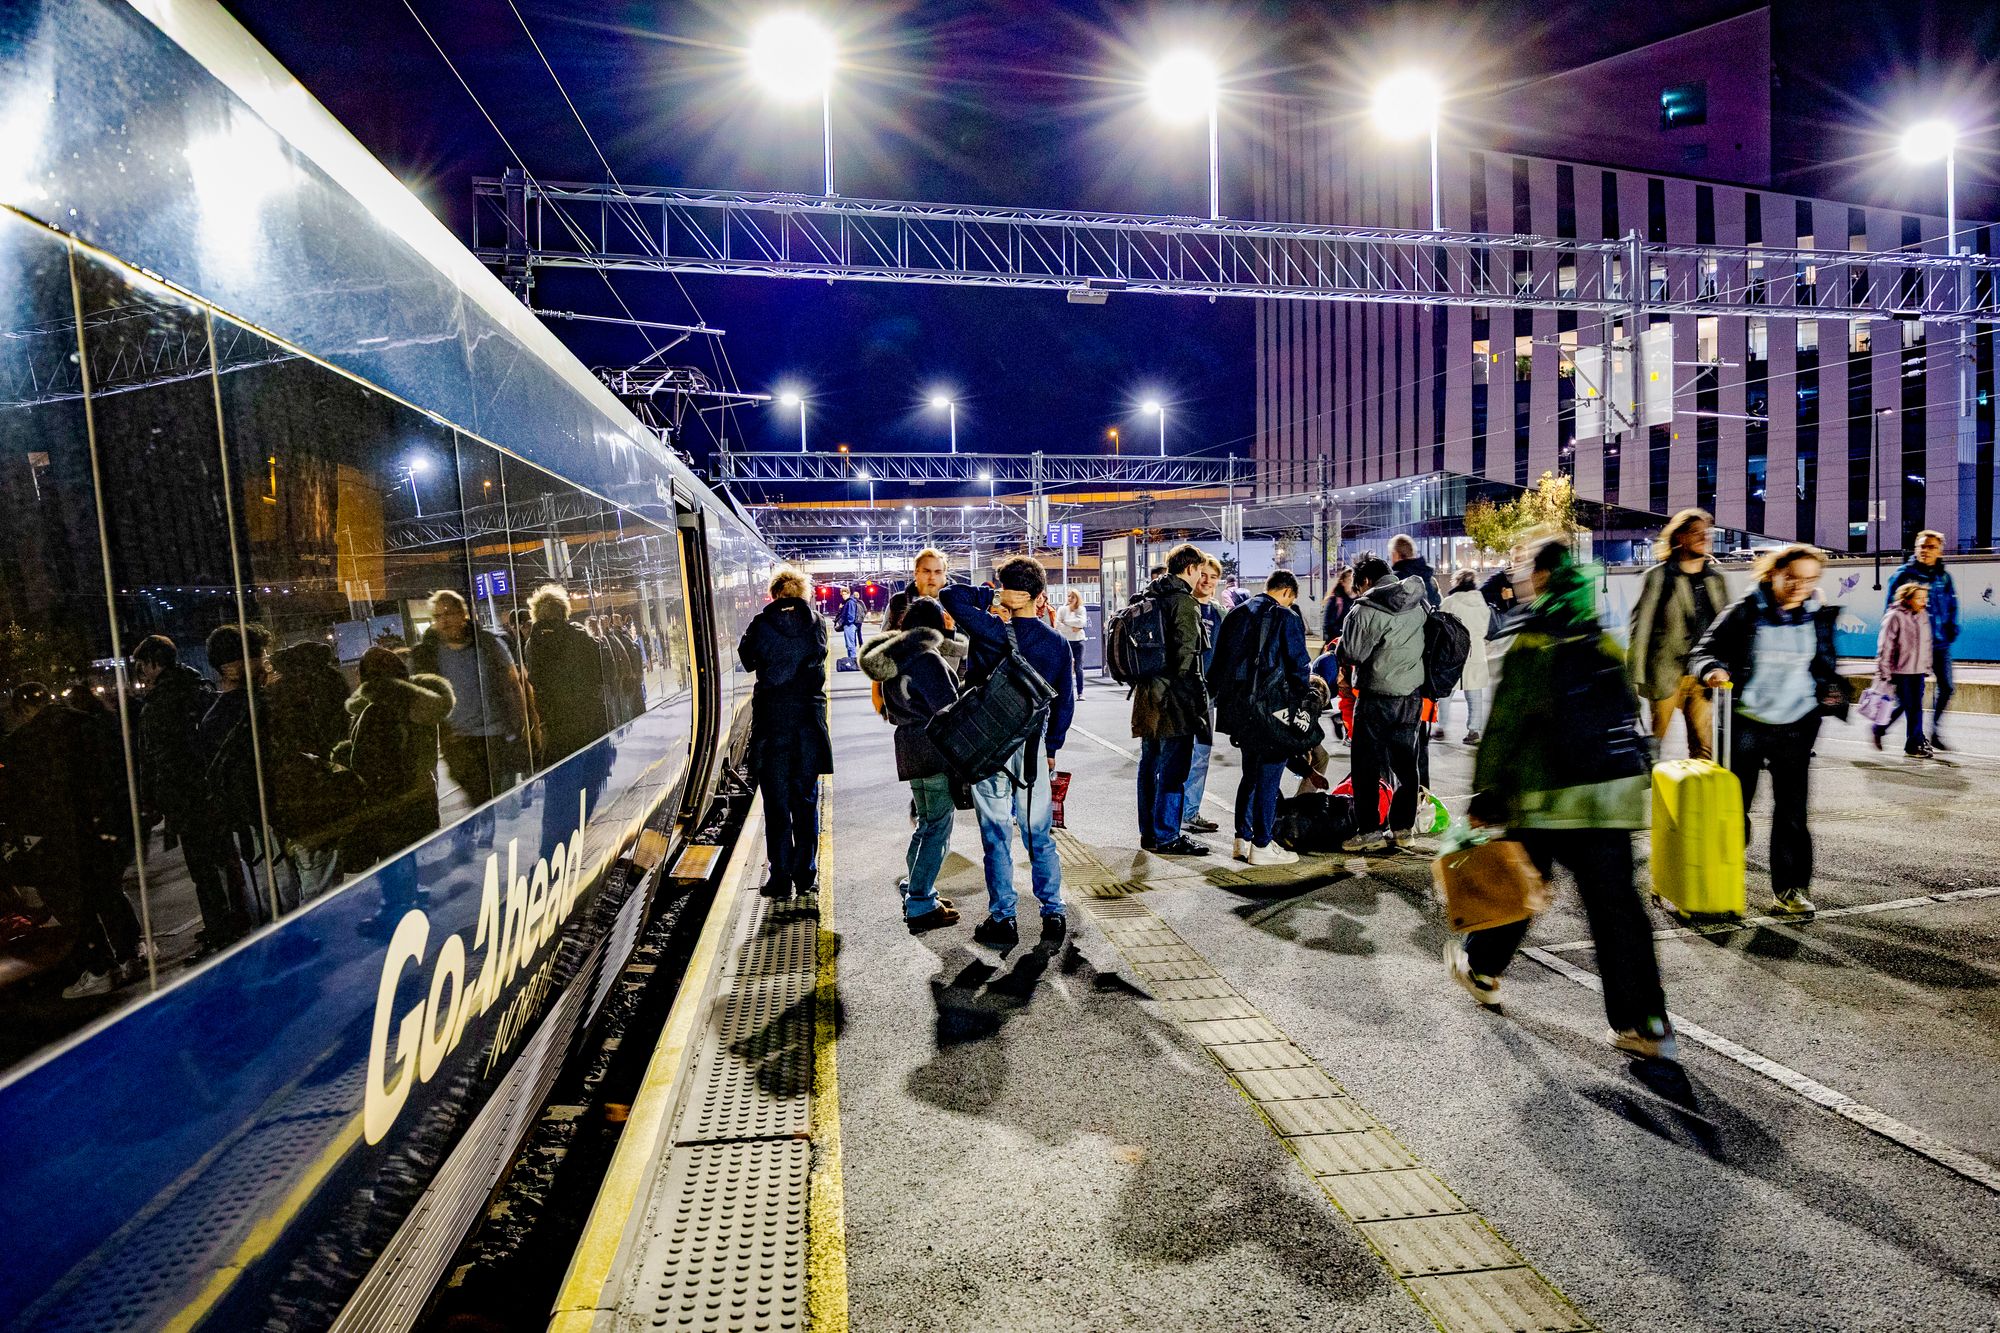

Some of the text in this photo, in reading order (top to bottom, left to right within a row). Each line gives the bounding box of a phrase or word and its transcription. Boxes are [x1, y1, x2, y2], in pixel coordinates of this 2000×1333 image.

[1051, 533, 1058, 543] E
[1072, 533, 1079, 543] E
[364, 787, 587, 1146] Go-Ahead
